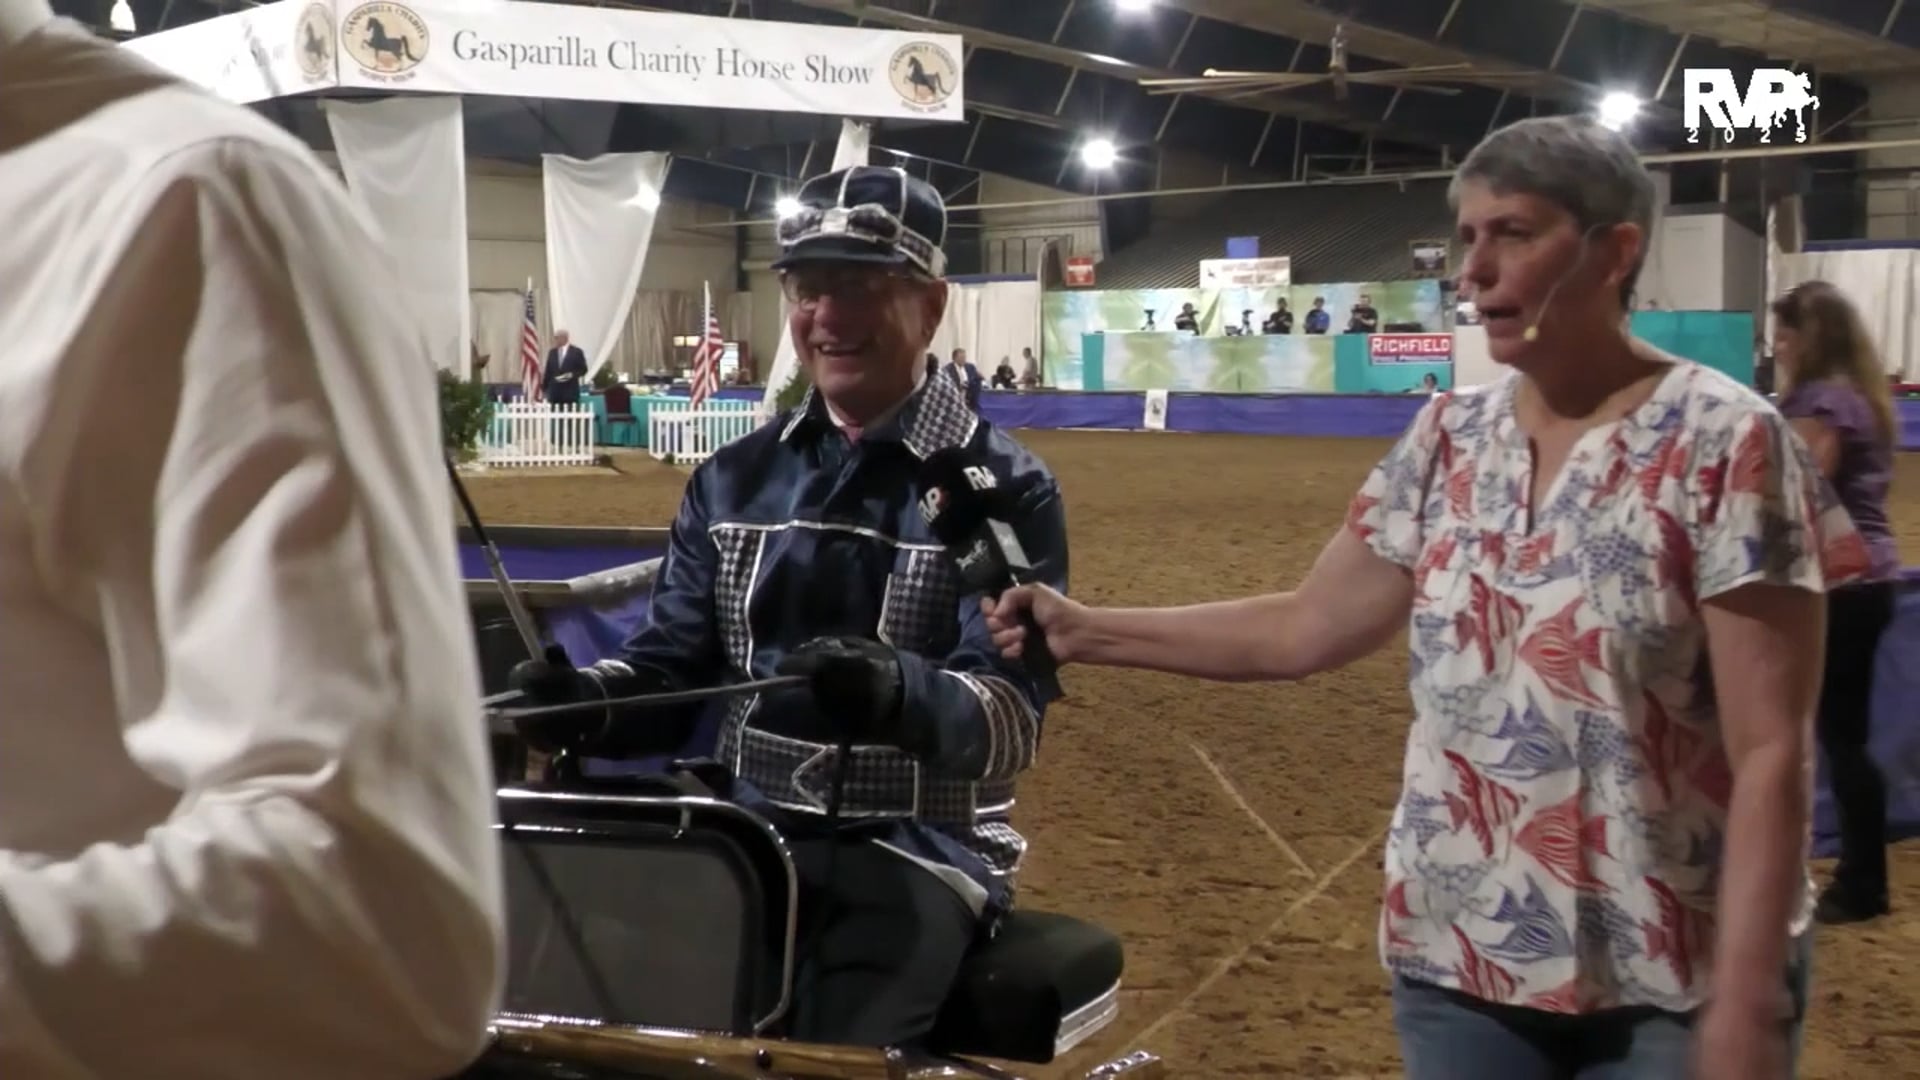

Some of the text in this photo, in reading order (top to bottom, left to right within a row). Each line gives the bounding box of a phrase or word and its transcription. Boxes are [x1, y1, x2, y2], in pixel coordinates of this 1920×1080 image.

[453, 28, 597, 70] Gasparilla
[607, 40, 706, 82] Charity
[716, 47, 795, 80] Horse
[804, 53, 873, 84] Show
[1372, 338, 1450, 353] RICHFIELD
